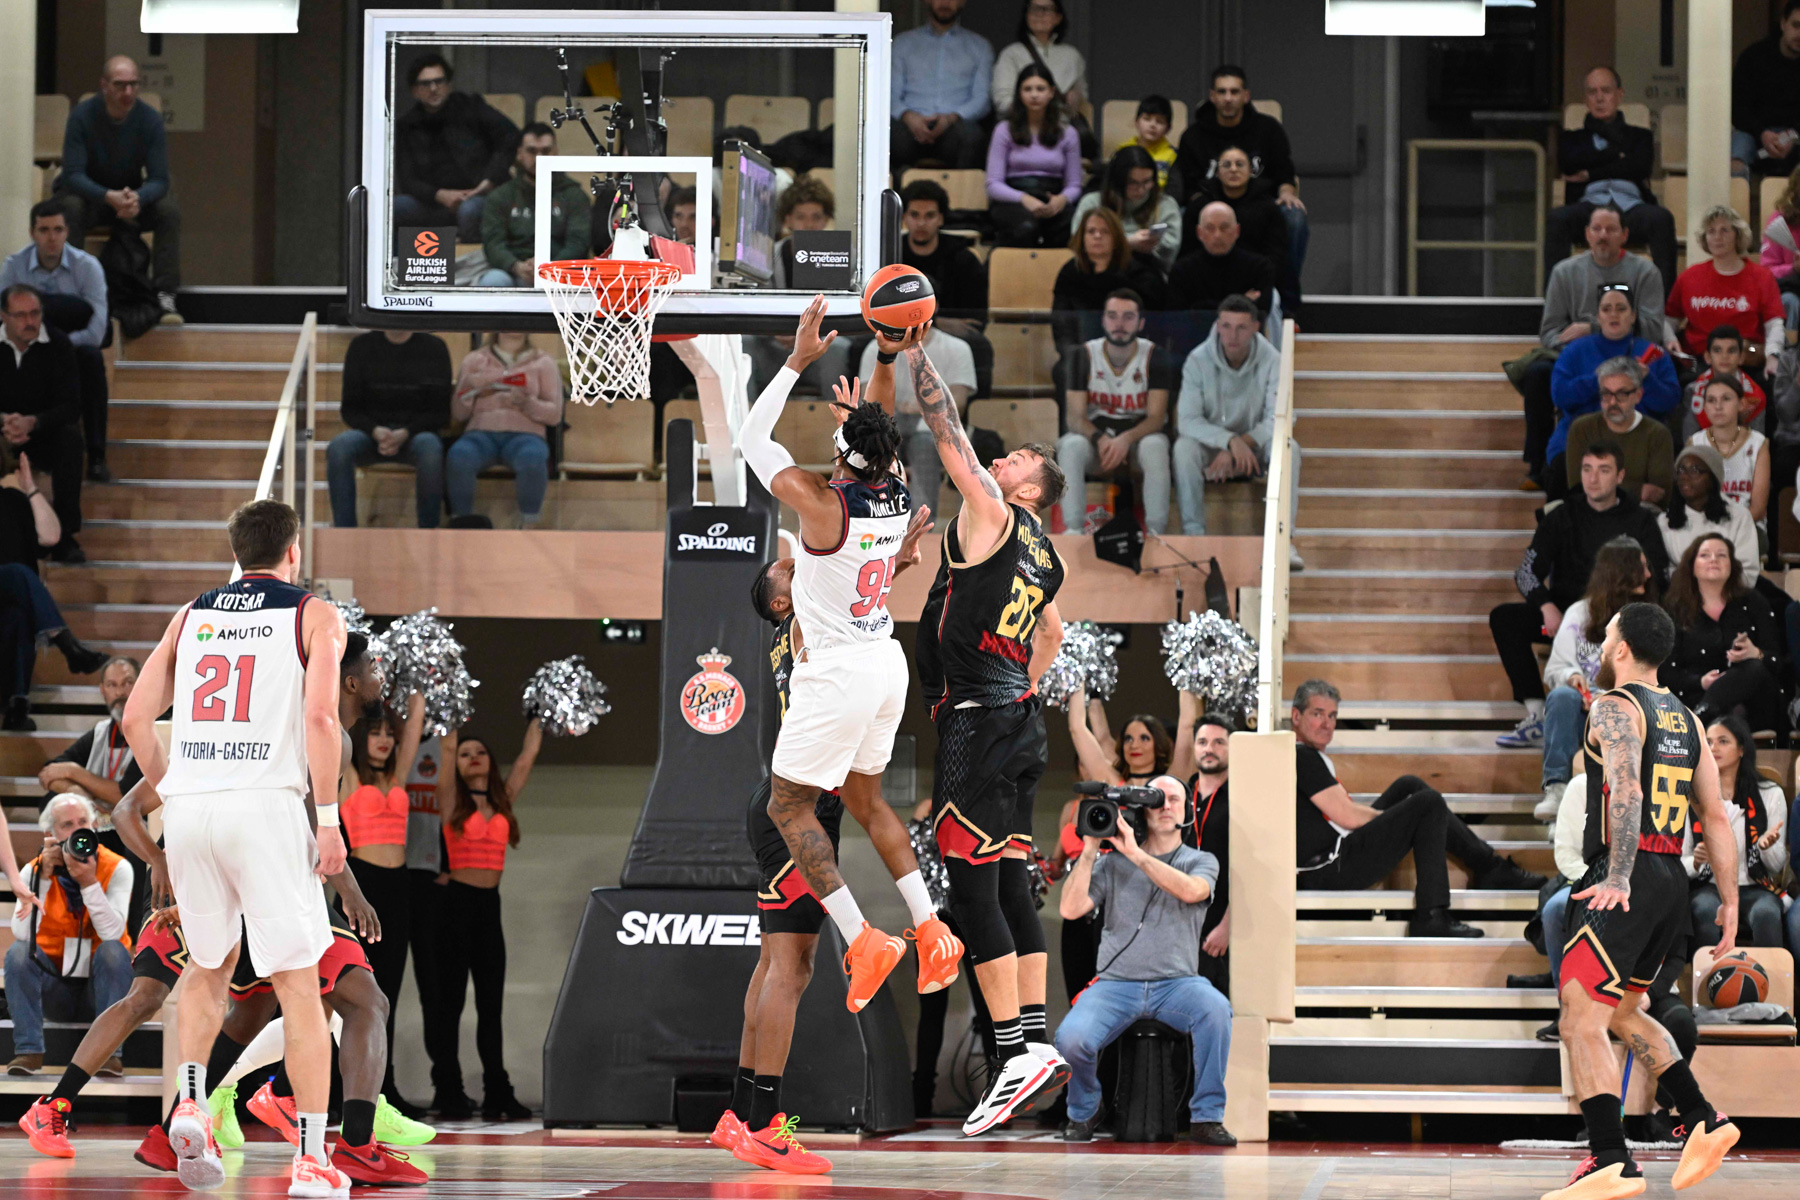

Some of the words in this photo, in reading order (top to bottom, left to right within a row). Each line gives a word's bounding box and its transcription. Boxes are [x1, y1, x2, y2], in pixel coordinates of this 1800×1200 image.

[406, 266, 447, 274] AIRLINES
[407, 258, 447, 266] TURKISH
[405, 274, 447, 283] EuroLeague
[383, 296, 434, 307] SPALDING
[678, 534, 756, 553] SPALDING
[213, 592, 265, 611] KOTSAR
[217, 625, 273, 640] AMUTIO
[192, 655, 256, 723] 21
[686, 684, 736, 709] Roca
[181, 741, 271, 760] ITORIA-GASTEIZ
[1651, 763, 1694, 834] 55
